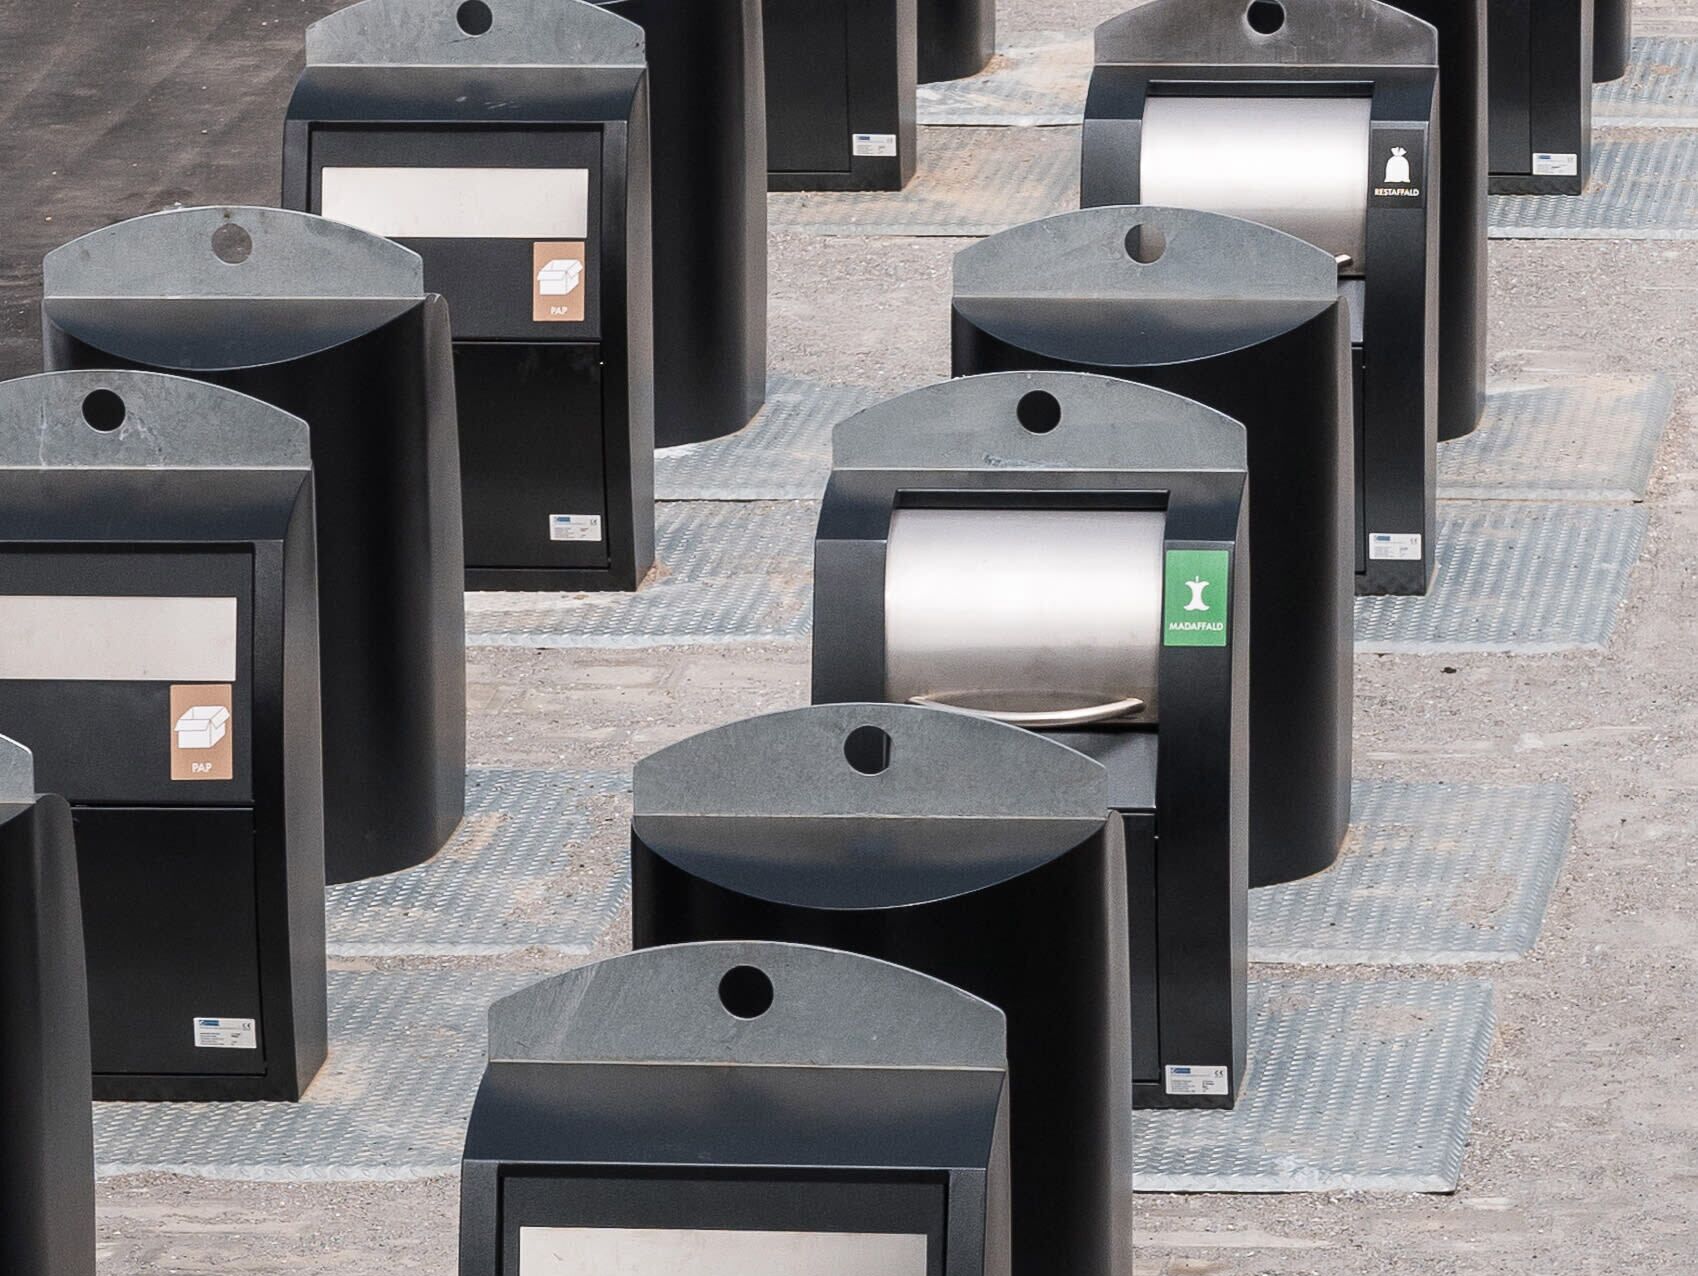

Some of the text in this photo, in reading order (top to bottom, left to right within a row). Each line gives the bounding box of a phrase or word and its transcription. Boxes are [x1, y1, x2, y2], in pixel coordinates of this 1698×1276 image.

[1374, 188, 1420, 197] RESTAFFALD
[551, 306, 568, 315] PAP
[1168, 621, 1224, 631] MADAFFALD
[191, 762, 212, 773] PAP
